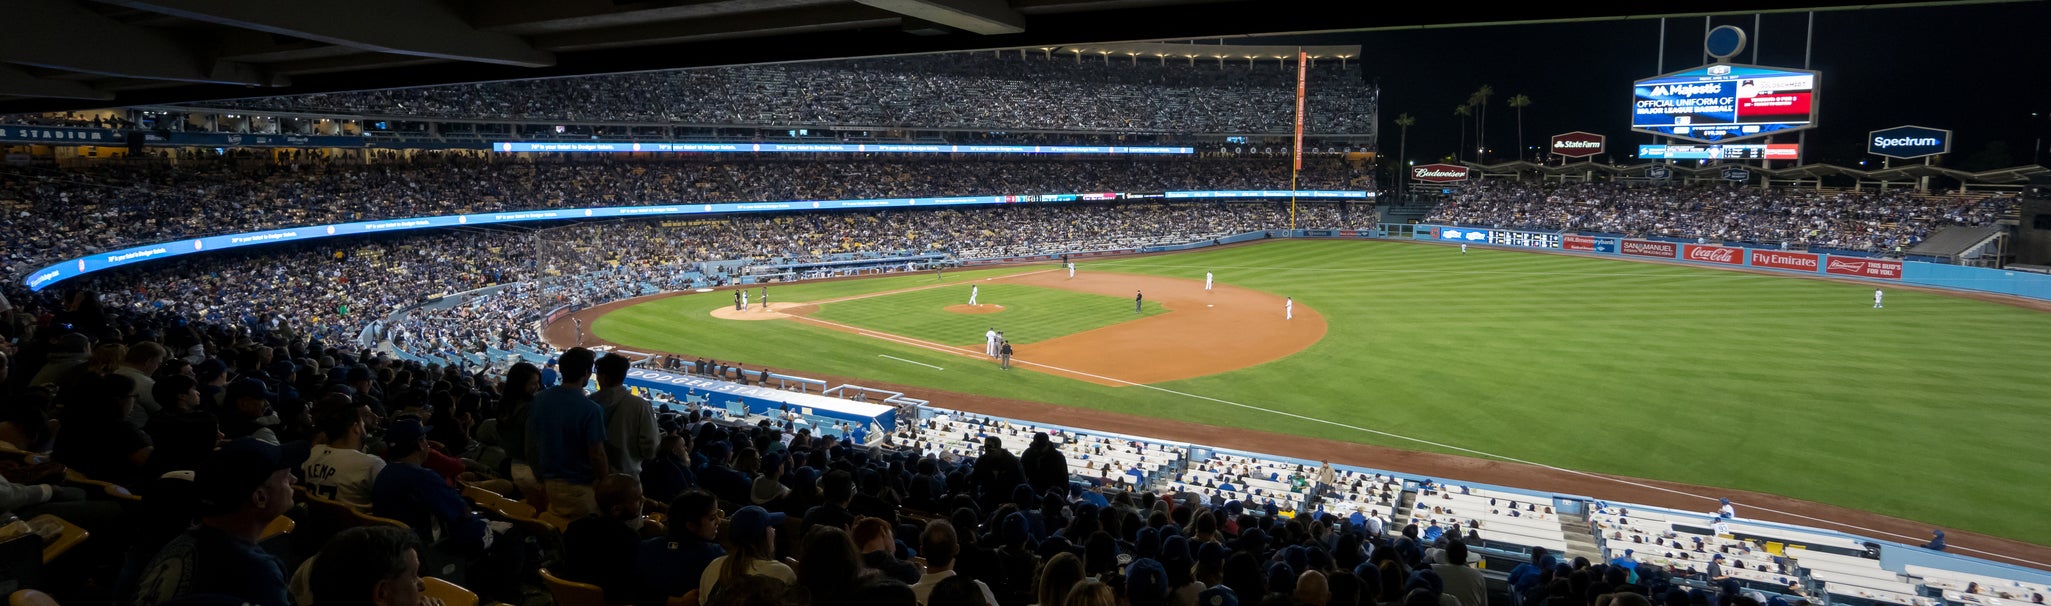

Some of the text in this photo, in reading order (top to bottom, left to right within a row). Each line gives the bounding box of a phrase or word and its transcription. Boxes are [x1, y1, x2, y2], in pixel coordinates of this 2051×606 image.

[1670, 83, 1721, 97] Majestic
[1676, 98, 1718, 106] UNIFORM
[20, 129, 102, 140] STADIUM
[1874, 137, 1935, 148] Spectrum
[1414, 168, 1466, 178] Budweiser
[1691, 247, 1735, 262] Coca-Cola
[1753, 253, 1816, 267] Fly Emirates
[628, 370, 713, 388] DODGER
[308, 464, 336, 480] KEMP
